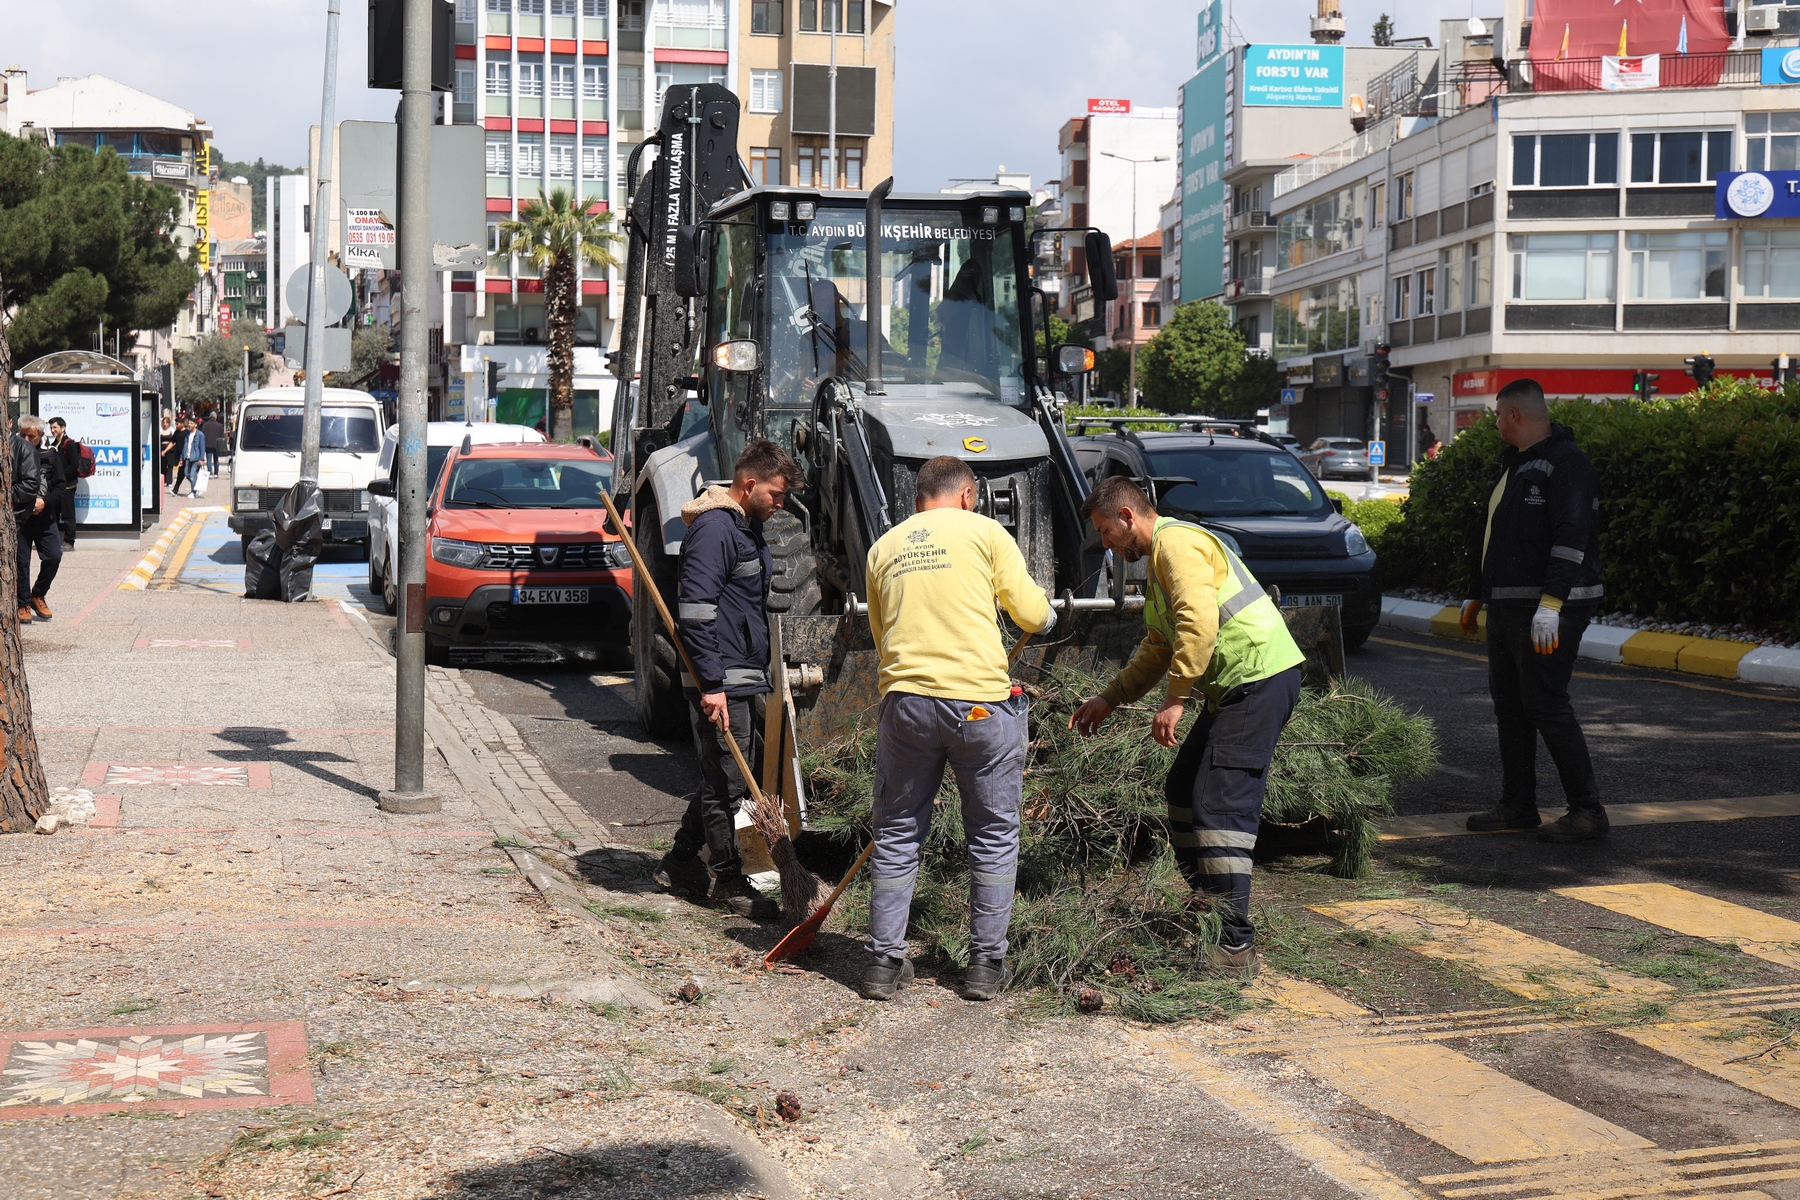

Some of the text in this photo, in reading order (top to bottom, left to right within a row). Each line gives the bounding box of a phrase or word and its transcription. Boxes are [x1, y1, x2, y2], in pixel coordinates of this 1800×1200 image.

[1267, 49, 1319, 60] AYDIN'IN
[1256, 66, 1328, 78] FORS'U VAR
[669, 133, 685, 190] YAKLAŞMA
[1206, 160, 1219, 186] VAR
[668, 192, 680, 226] FAZLA
[348, 232, 394, 243] 0535 031 19 06
[790, 226, 809, 236] T.C.
[812, 226, 845, 237] AYDIN
[934, 227, 996, 240] BELEDİYESİ
[1463, 378, 1485, 388] AKBANK
[80, 436, 110, 445] Alana
[95, 450, 123, 463] AM
[894, 548, 947, 564] BÜYÜKŞEHİR
[901, 558, 938, 568] BELEDİYESİ
[520, 590, 535, 602] 34
[538, 590, 561, 602] EKV
[565, 590, 588, 602] 358
[1288, 596, 1298, 606] 09
[1305, 596, 1322, 606] AAN
